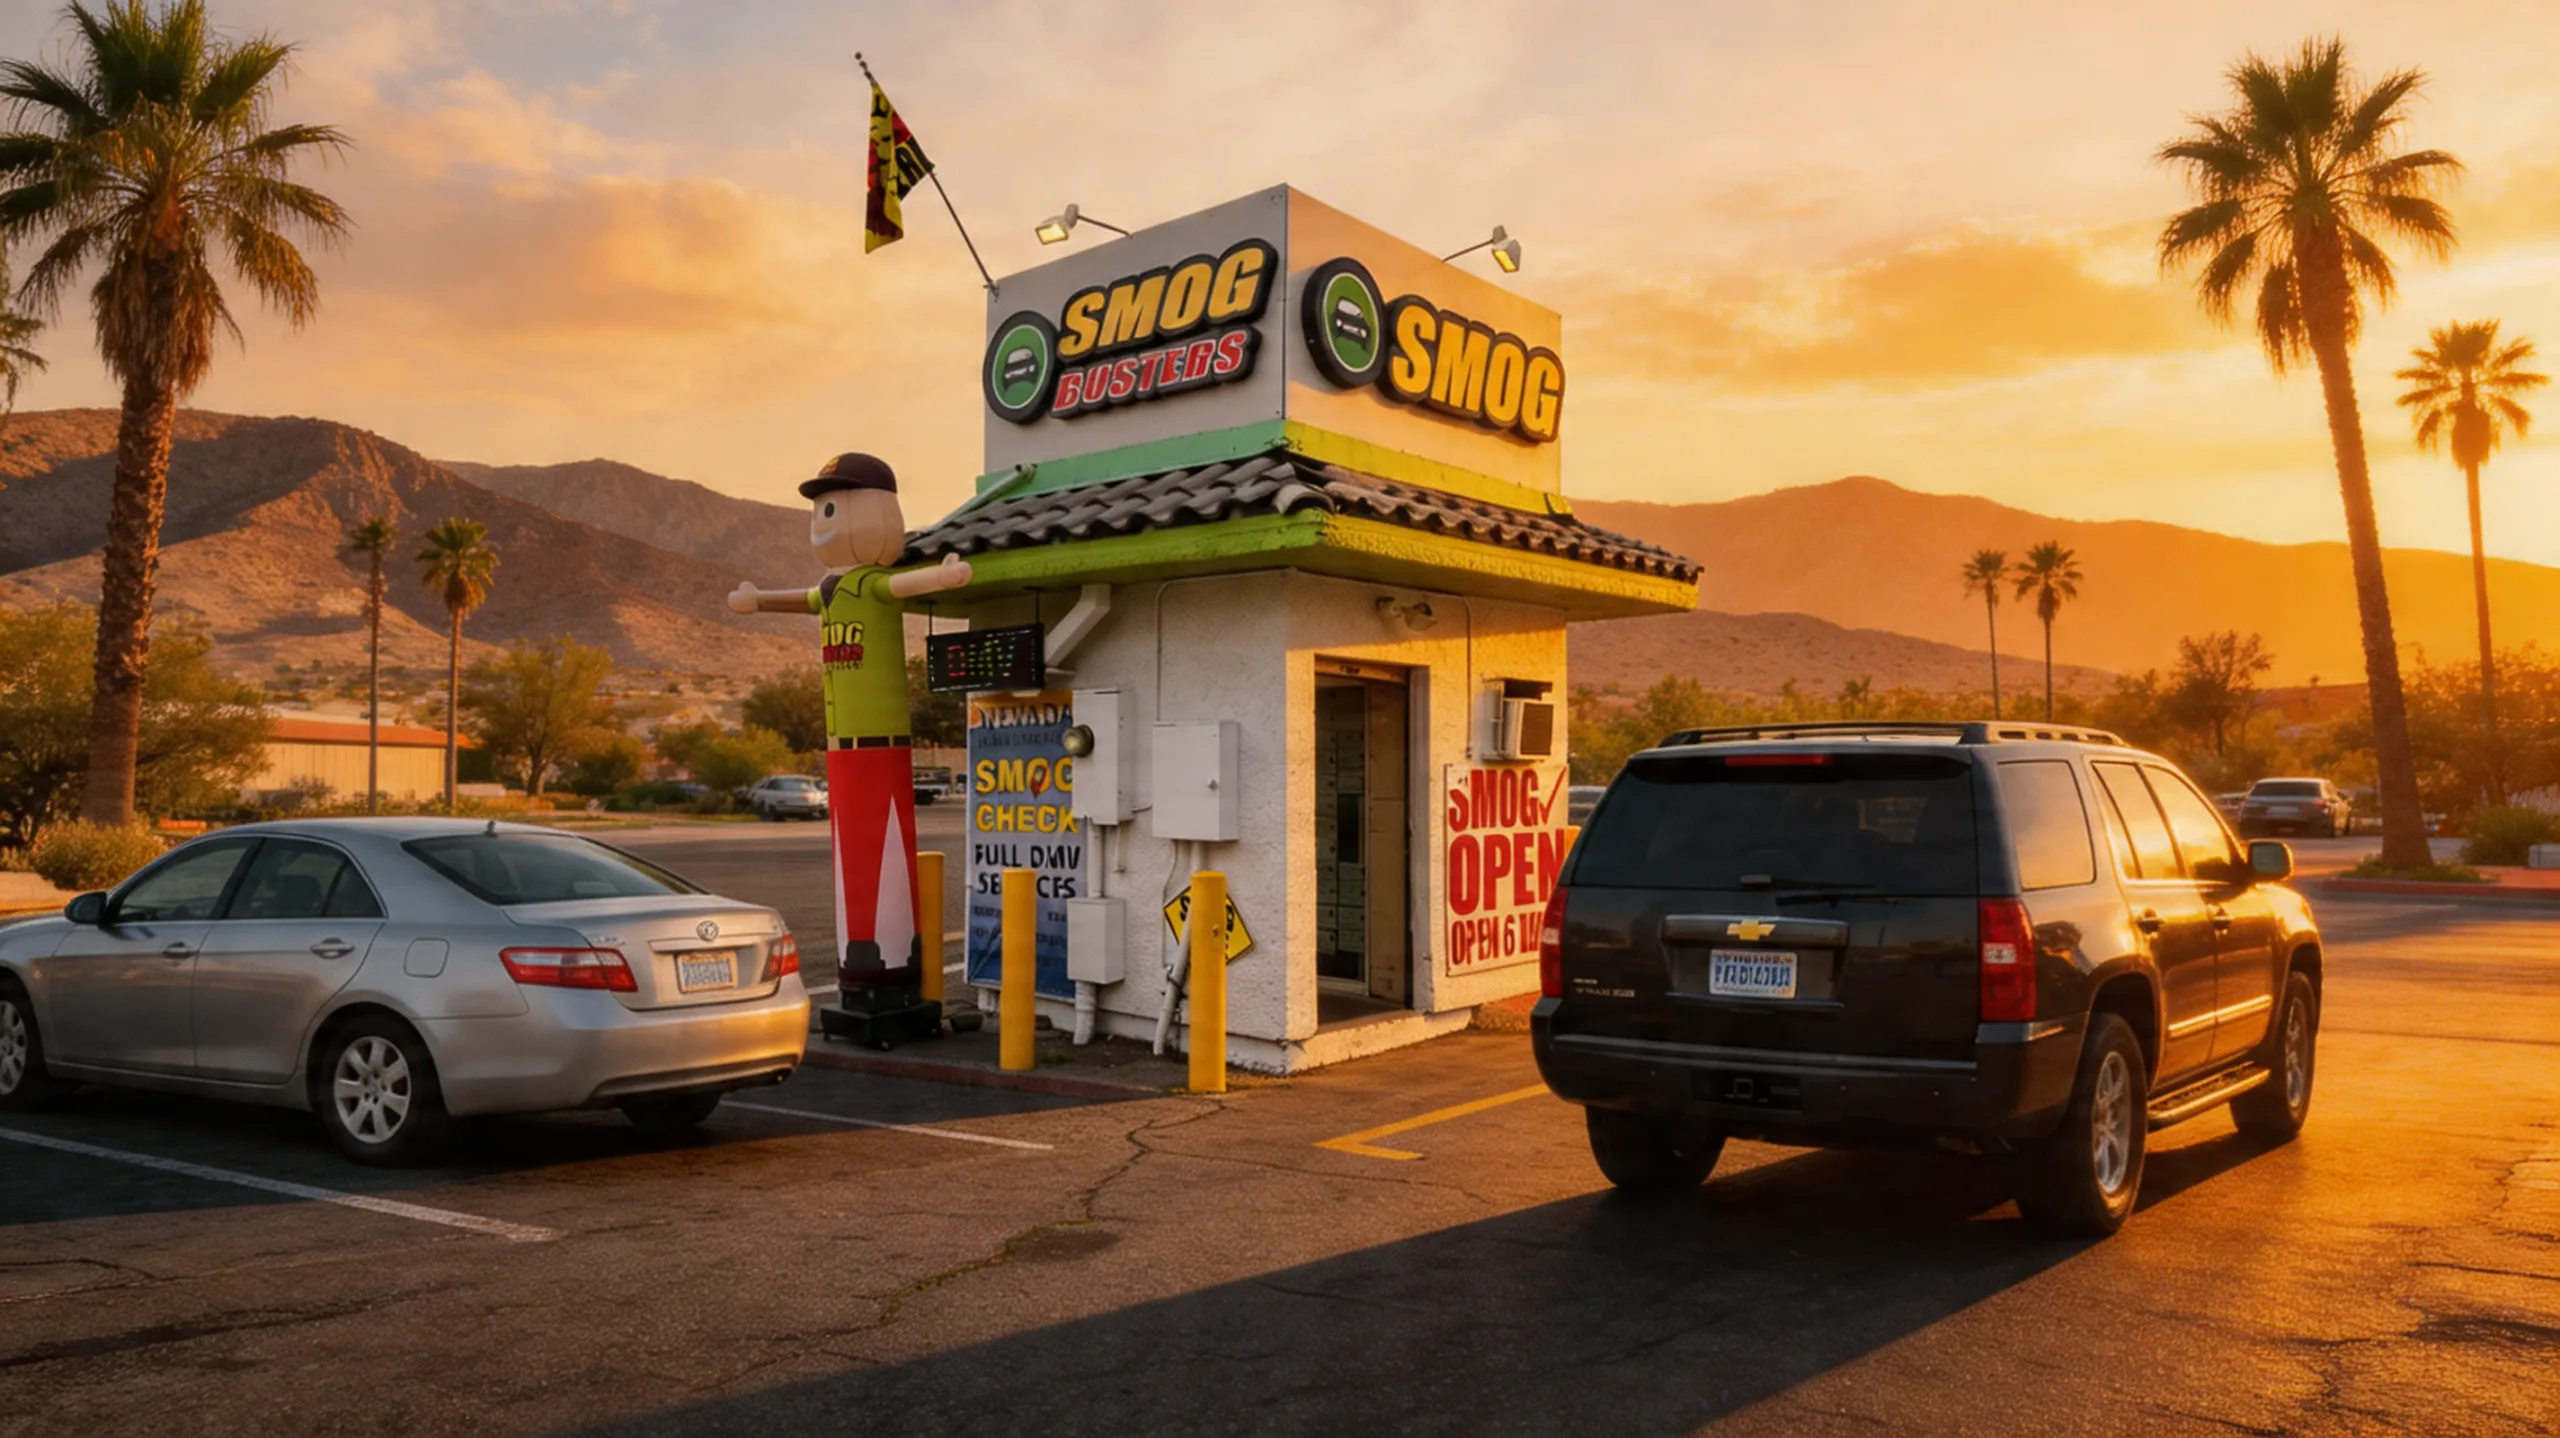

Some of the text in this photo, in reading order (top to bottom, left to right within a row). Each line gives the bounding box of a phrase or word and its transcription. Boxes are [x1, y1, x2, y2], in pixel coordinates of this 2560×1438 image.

[1058, 247, 1265, 358] SMOG
[1052, 329, 1248, 412] BUSTERS
[1390, 304, 1565, 440] SMOG
[976, 803, 1080, 834] CHECK
[1448, 768, 1539, 833] SMOG
[1030, 844, 1081, 870] DMV
[1448, 829, 1565, 916] OPEN
[1451, 917, 1500, 966] OPEN
[1503, 913, 1516, 957] 6
